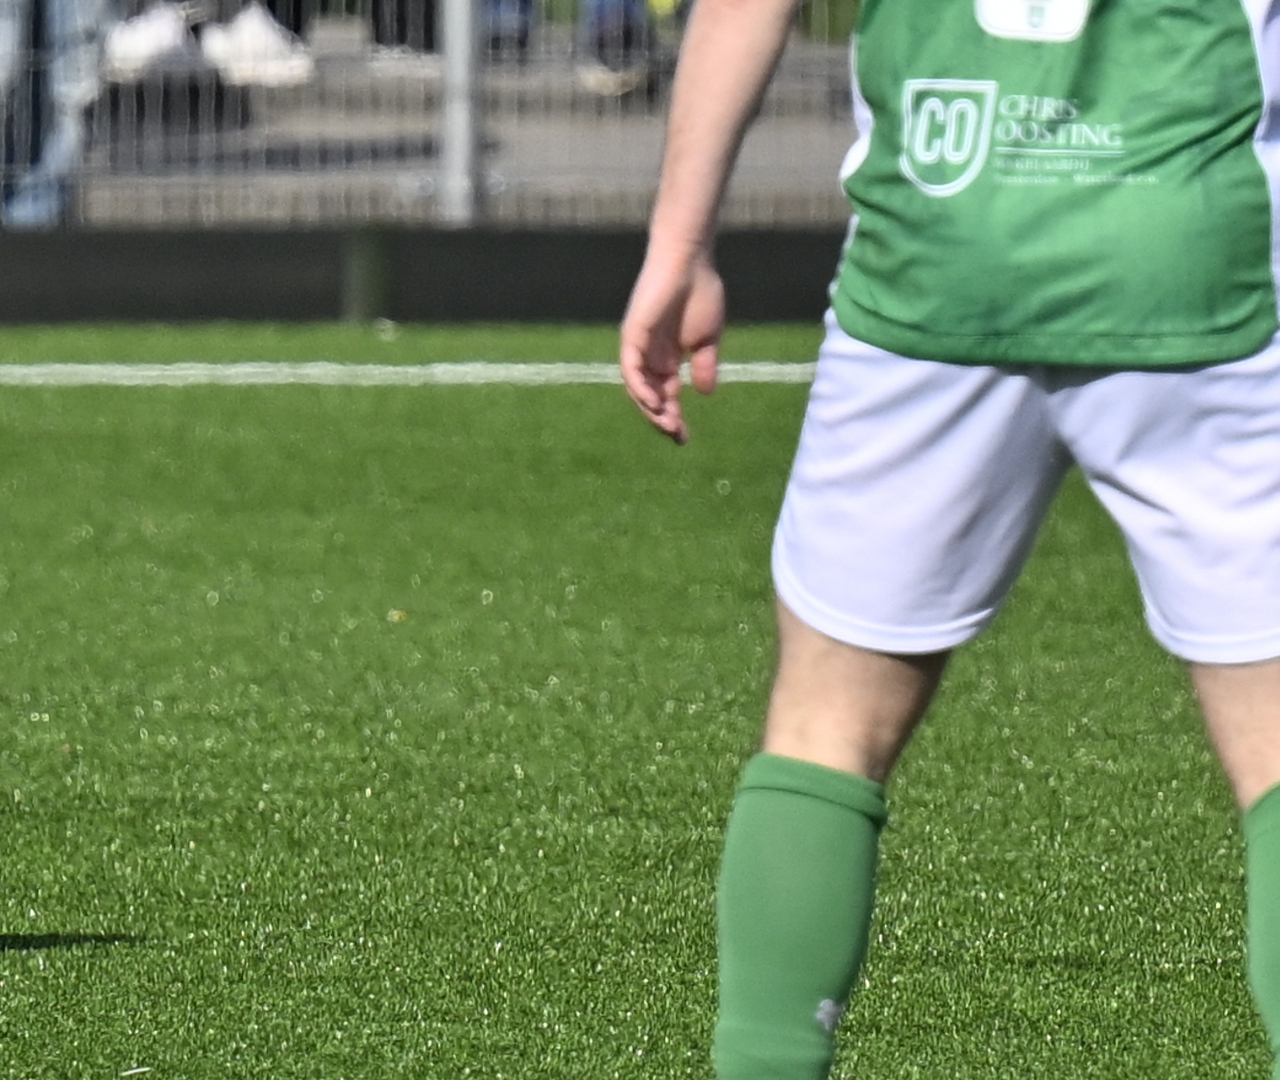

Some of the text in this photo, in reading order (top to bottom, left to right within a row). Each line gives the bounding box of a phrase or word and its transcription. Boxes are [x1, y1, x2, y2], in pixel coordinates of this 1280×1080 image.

[1000, 94, 1078, 119] CHRIS
[914, 96, 980, 164] CO
[994, 119, 1124, 147] OOSTING
